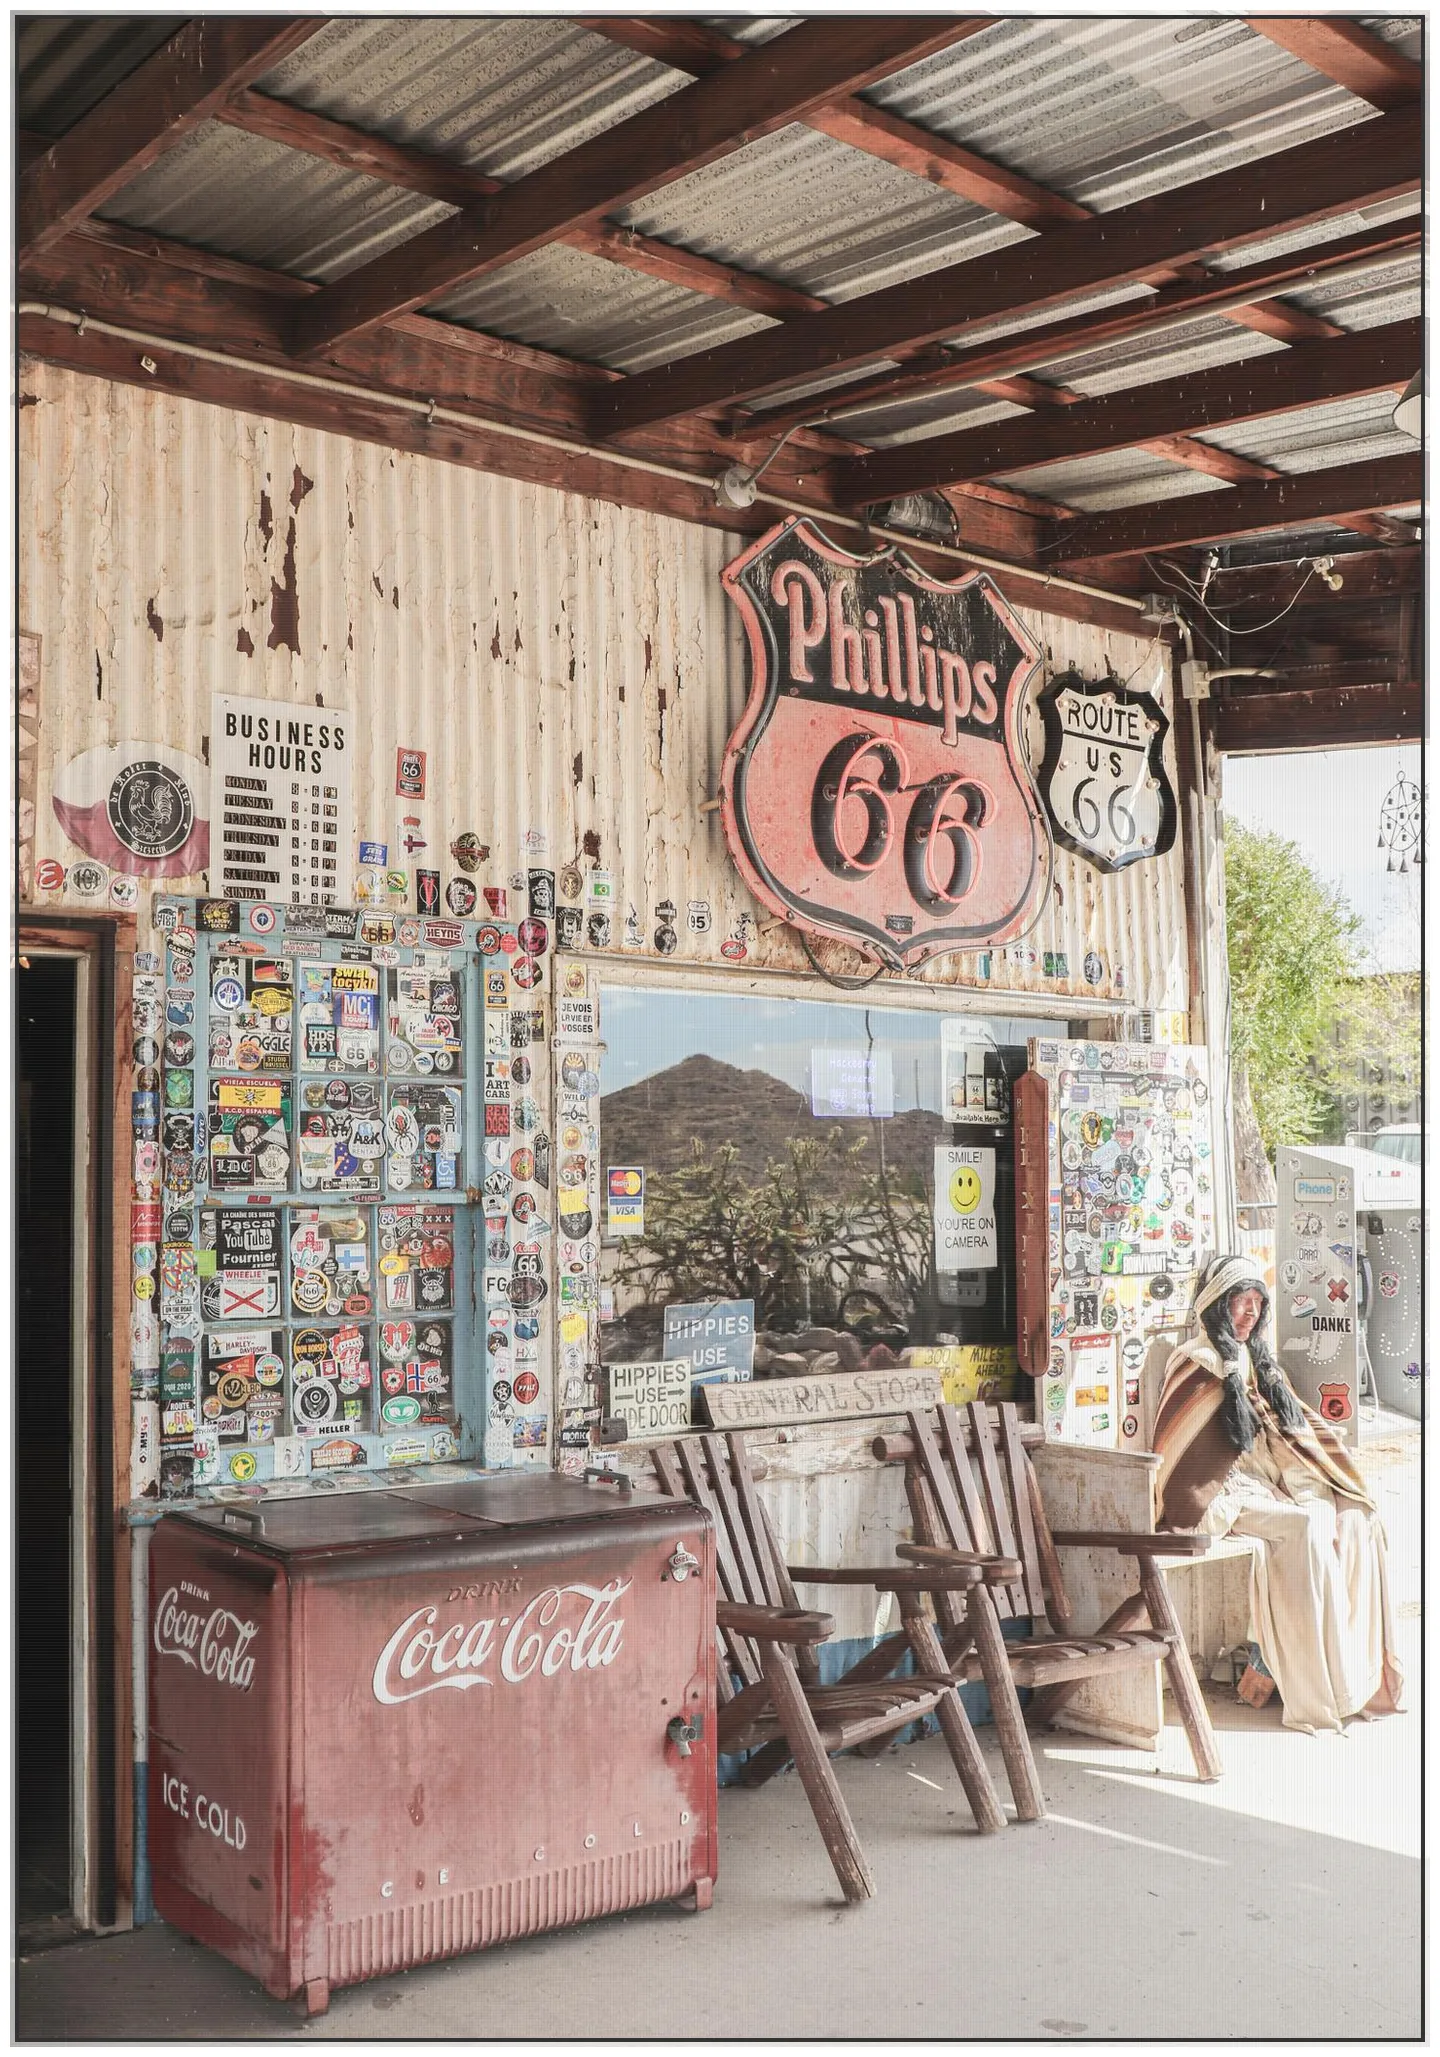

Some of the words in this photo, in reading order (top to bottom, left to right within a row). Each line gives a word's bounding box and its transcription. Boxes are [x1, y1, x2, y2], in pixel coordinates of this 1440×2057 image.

[770, 560, 998, 749] Phillips
[1067, 698, 1141, 741] ROUTE
[226, 712, 344, 751] BUSINESS
[249, 743, 322, 775] HOURS
[402, 763, 421, 776] 66
[225, 775, 267, 791] MONDAY
[291, 783, 299, 795] 8
[311, 785, 319, 798] 6
[324, 786, 338, 799] PM
[224, 793, 274, 811] TUESDAY
[291, 801, 299, 813] 8
[311, 803, 319, 815] 6
[324, 804, 338, 817] PM
[1071, 776, 1138, 847] 66
[224, 812, 287, 829] WEDNESDAY
[291, 818, 299, 831] 8
[311, 821, 319, 833] 6
[323, 822, 338, 835] PM
[809, 731, 999, 919] 66
[224, 830, 280, 847] THURSDAY
[291, 837, 299, 849] 8
[311, 839, 319, 851] 6
[322, 840, 337, 853] PM
[291, 855, 299, 867] 8
[311, 857, 319, 869] 6
[322, 858, 337, 870] PM
[224, 867, 280, 884] SATURDAY
[291, 873, 299, 886] 8
[311, 874, 318, 887] 6
[321, 875, 337, 889] PM
[224, 886, 266, 900] SUNDAY
[291, 891, 299, 904] 8
[311, 892, 318, 905] 6
[690, 915, 706, 929] 95
[427, 928, 462, 940] HEYNS
[489, 980, 505, 992] 66
[432, 1003, 458, 1014] CHICAGO
[561, 1003, 573, 1013] JE
[572, 1003, 593, 1013] VOIS
[561, 1023, 594, 1033] VOSGES
[346, 1048, 365, 1060] 66
[486, 1061, 495, 1078] I
[486, 1079, 511, 1090] ART
[485, 1089, 511, 1099] CARS
[563, 1093, 586, 1101] WILD
[485, 1116, 510, 1134] DOGS
[353, 1133, 382, 1146] A&K
[947, 1150, 983, 1165] SMILE!
[1297, 1181, 1333, 1196] Phone
[615, 1206, 636, 1216] VISA
[221, 1219, 276, 1231] Pascal
[381, 1214, 395, 1226] 66
[937, 1216, 976, 1232] YOU'RE
[977, 1216, 995, 1231] ON
[944, 1234, 989, 1250] CAMERA
[222, 1251, 278, 1266] Fournier
[516, 1256, 538, 1272] 66
[225, 1270, 262, 1280] WHEELIE
[486, 1277, 507, 1292] FG
[668, 1314, 750, 1341] HIPPIES
[1311, 1316, 1351, 1333] DANKE
[692, 1346, 728, 1367] USE
[969, 1346, 1006, 1364] MILES
[427, 1373, 439, 1384] 66
[613, 1362, 687, 1388] HIPPIES
[974, 1363, 1006, 1378] AHEAD
[634, 1386, 668, 1405] USE
[718, 1380, 848, 1423] GENERAL
[854, 1374, 938, 1413] STORE
[170, 1401, 191, 1410] ROUTE
[174, 1411, 188, 1425] 66
[650, 1401, 689, 1427] DOOR
[319, 1423, 351, 1435] HELLER
[179, 1579, 211, 1603] DRINK
[445, 1577, 524, 1604] DRINK
[153, 1583, 260, 1690] Coca-Cola
[371, 1574, 635, 1705] Coca-Cola
[162, 1772, 190, 1820] ICE
[195, 1795, 249, 1852] COLD
